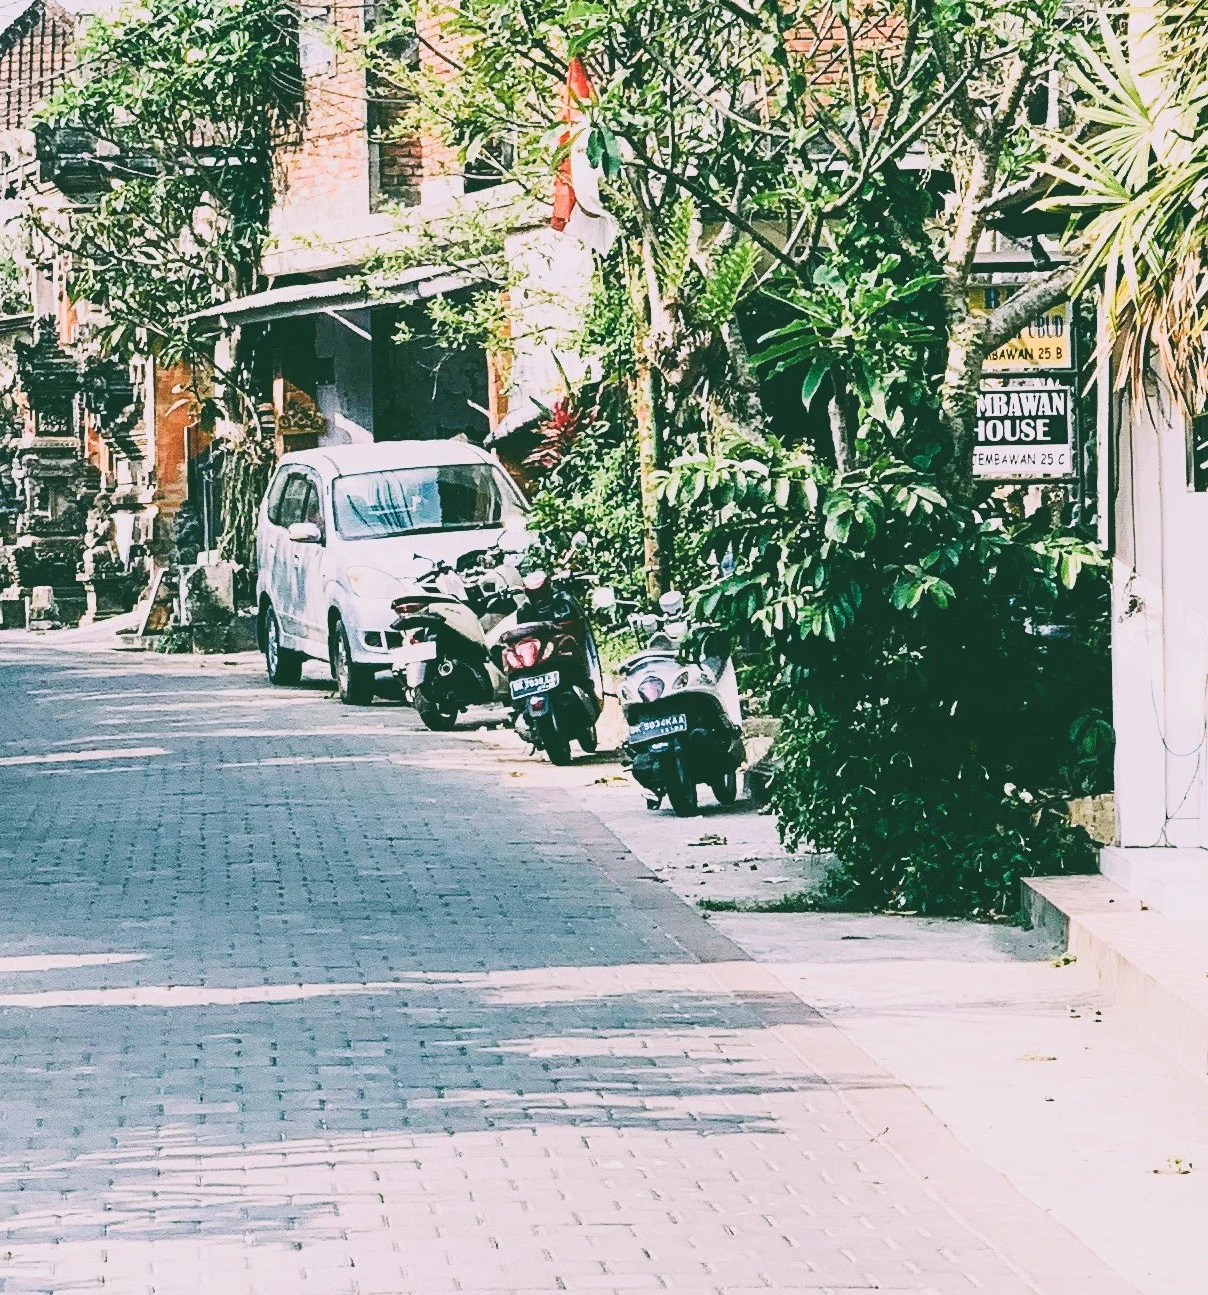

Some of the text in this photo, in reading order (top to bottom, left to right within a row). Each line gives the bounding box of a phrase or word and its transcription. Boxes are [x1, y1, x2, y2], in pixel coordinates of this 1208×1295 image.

[1038, 347, 1051, 359] 25
[1056, 347, 1062, 359] B
[1041, 453, 1053, 465] 25
[1058, 454, 1065, 464] C
